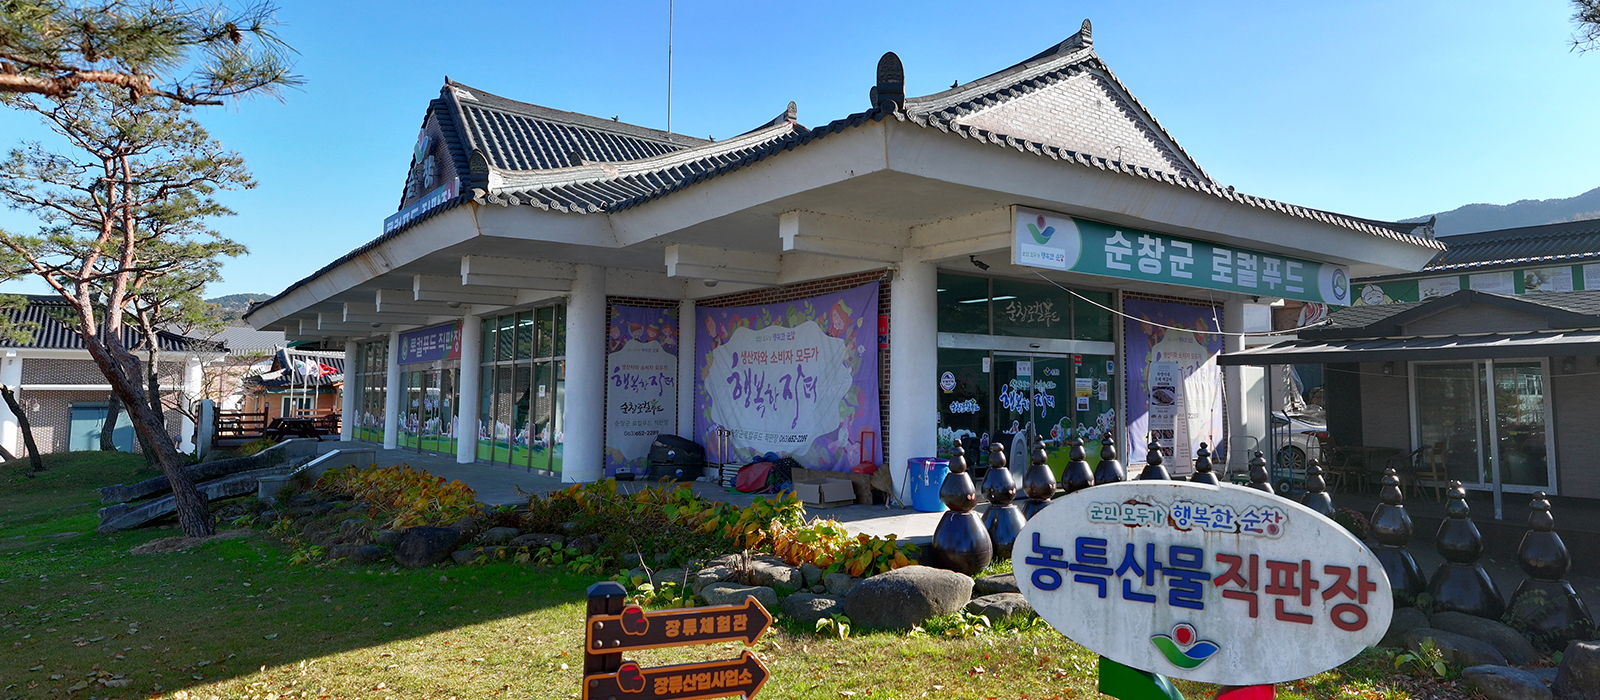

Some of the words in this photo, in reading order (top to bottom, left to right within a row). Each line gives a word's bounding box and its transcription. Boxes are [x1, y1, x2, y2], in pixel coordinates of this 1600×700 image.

[1105, 230, 1194, 279] 순창군
[1212, 248, 1304, 293] 로컬푸드
[410, 334, 437, 358] 로컬푸드
[741, 350, 768, 365] 생산자와
[770, 349, 793, 365] 소비자
[796, 346, 819, 363] 모두가
[611, 366, 648, 394] 행복한
[726, 352, 779, 418] 행복한
[1090, 505, 1117, 520] 군민
[1123, 507, 1162, 524] 모두가
[1173, 504, 1233, 529] 행복한
[1240, 509, 1283, 536] 순창
[1025, 532, 1211, 610] 농특산물
[1213, 552, 1377, 632] 직판장
[665, 614, 748, 637] 장류체험관
[654, 668, 752, 695] 장류산업사업소
